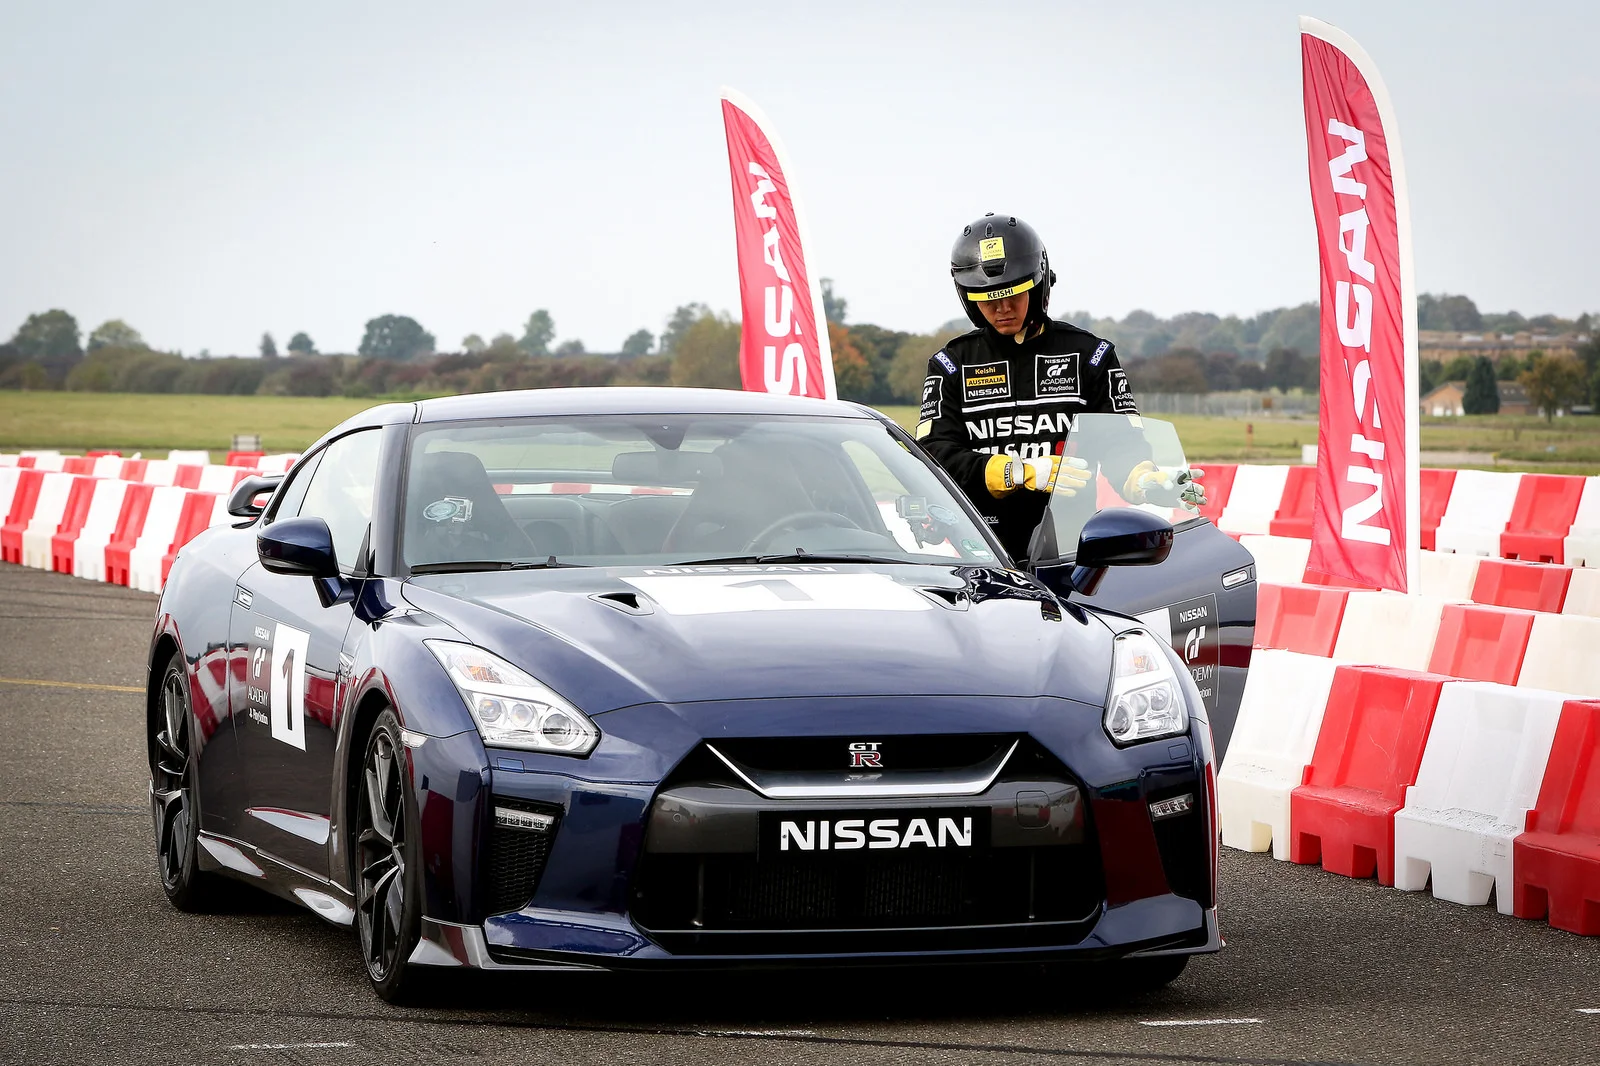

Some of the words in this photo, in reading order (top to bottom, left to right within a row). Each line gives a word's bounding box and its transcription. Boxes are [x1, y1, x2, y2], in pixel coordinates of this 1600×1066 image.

[748, 161, 808, 396] SSAN
[986, 287, 1014, 299] KEISHI
[1328, 118, 1391, 546] NISSAN
[974, 366, 996, 375] Keishi
[968, 377, 1004, 386] AUSTRALIA
[1040, 376, 1076, 386] ACADEMY
[968, 387, 1007, 398] NISSAN
[965, 413, 1079, 440] NISSAN
[643, 565, 837, 576] NISSAN
[723, 579, 814, 601] 1
[1179, 606, 1208, 623] NISSAN
[254, 625, 271, 641] NISSAN
[1192, 664, 1214, 682] DEMY
[247, 685, 269, 707] ACADEMY
[282, 648, 295, 731] 1
[848, 742, 882, 751] GT
[849, 751, 884, 767] R
[780, 817, 972, 850] NISSAN
